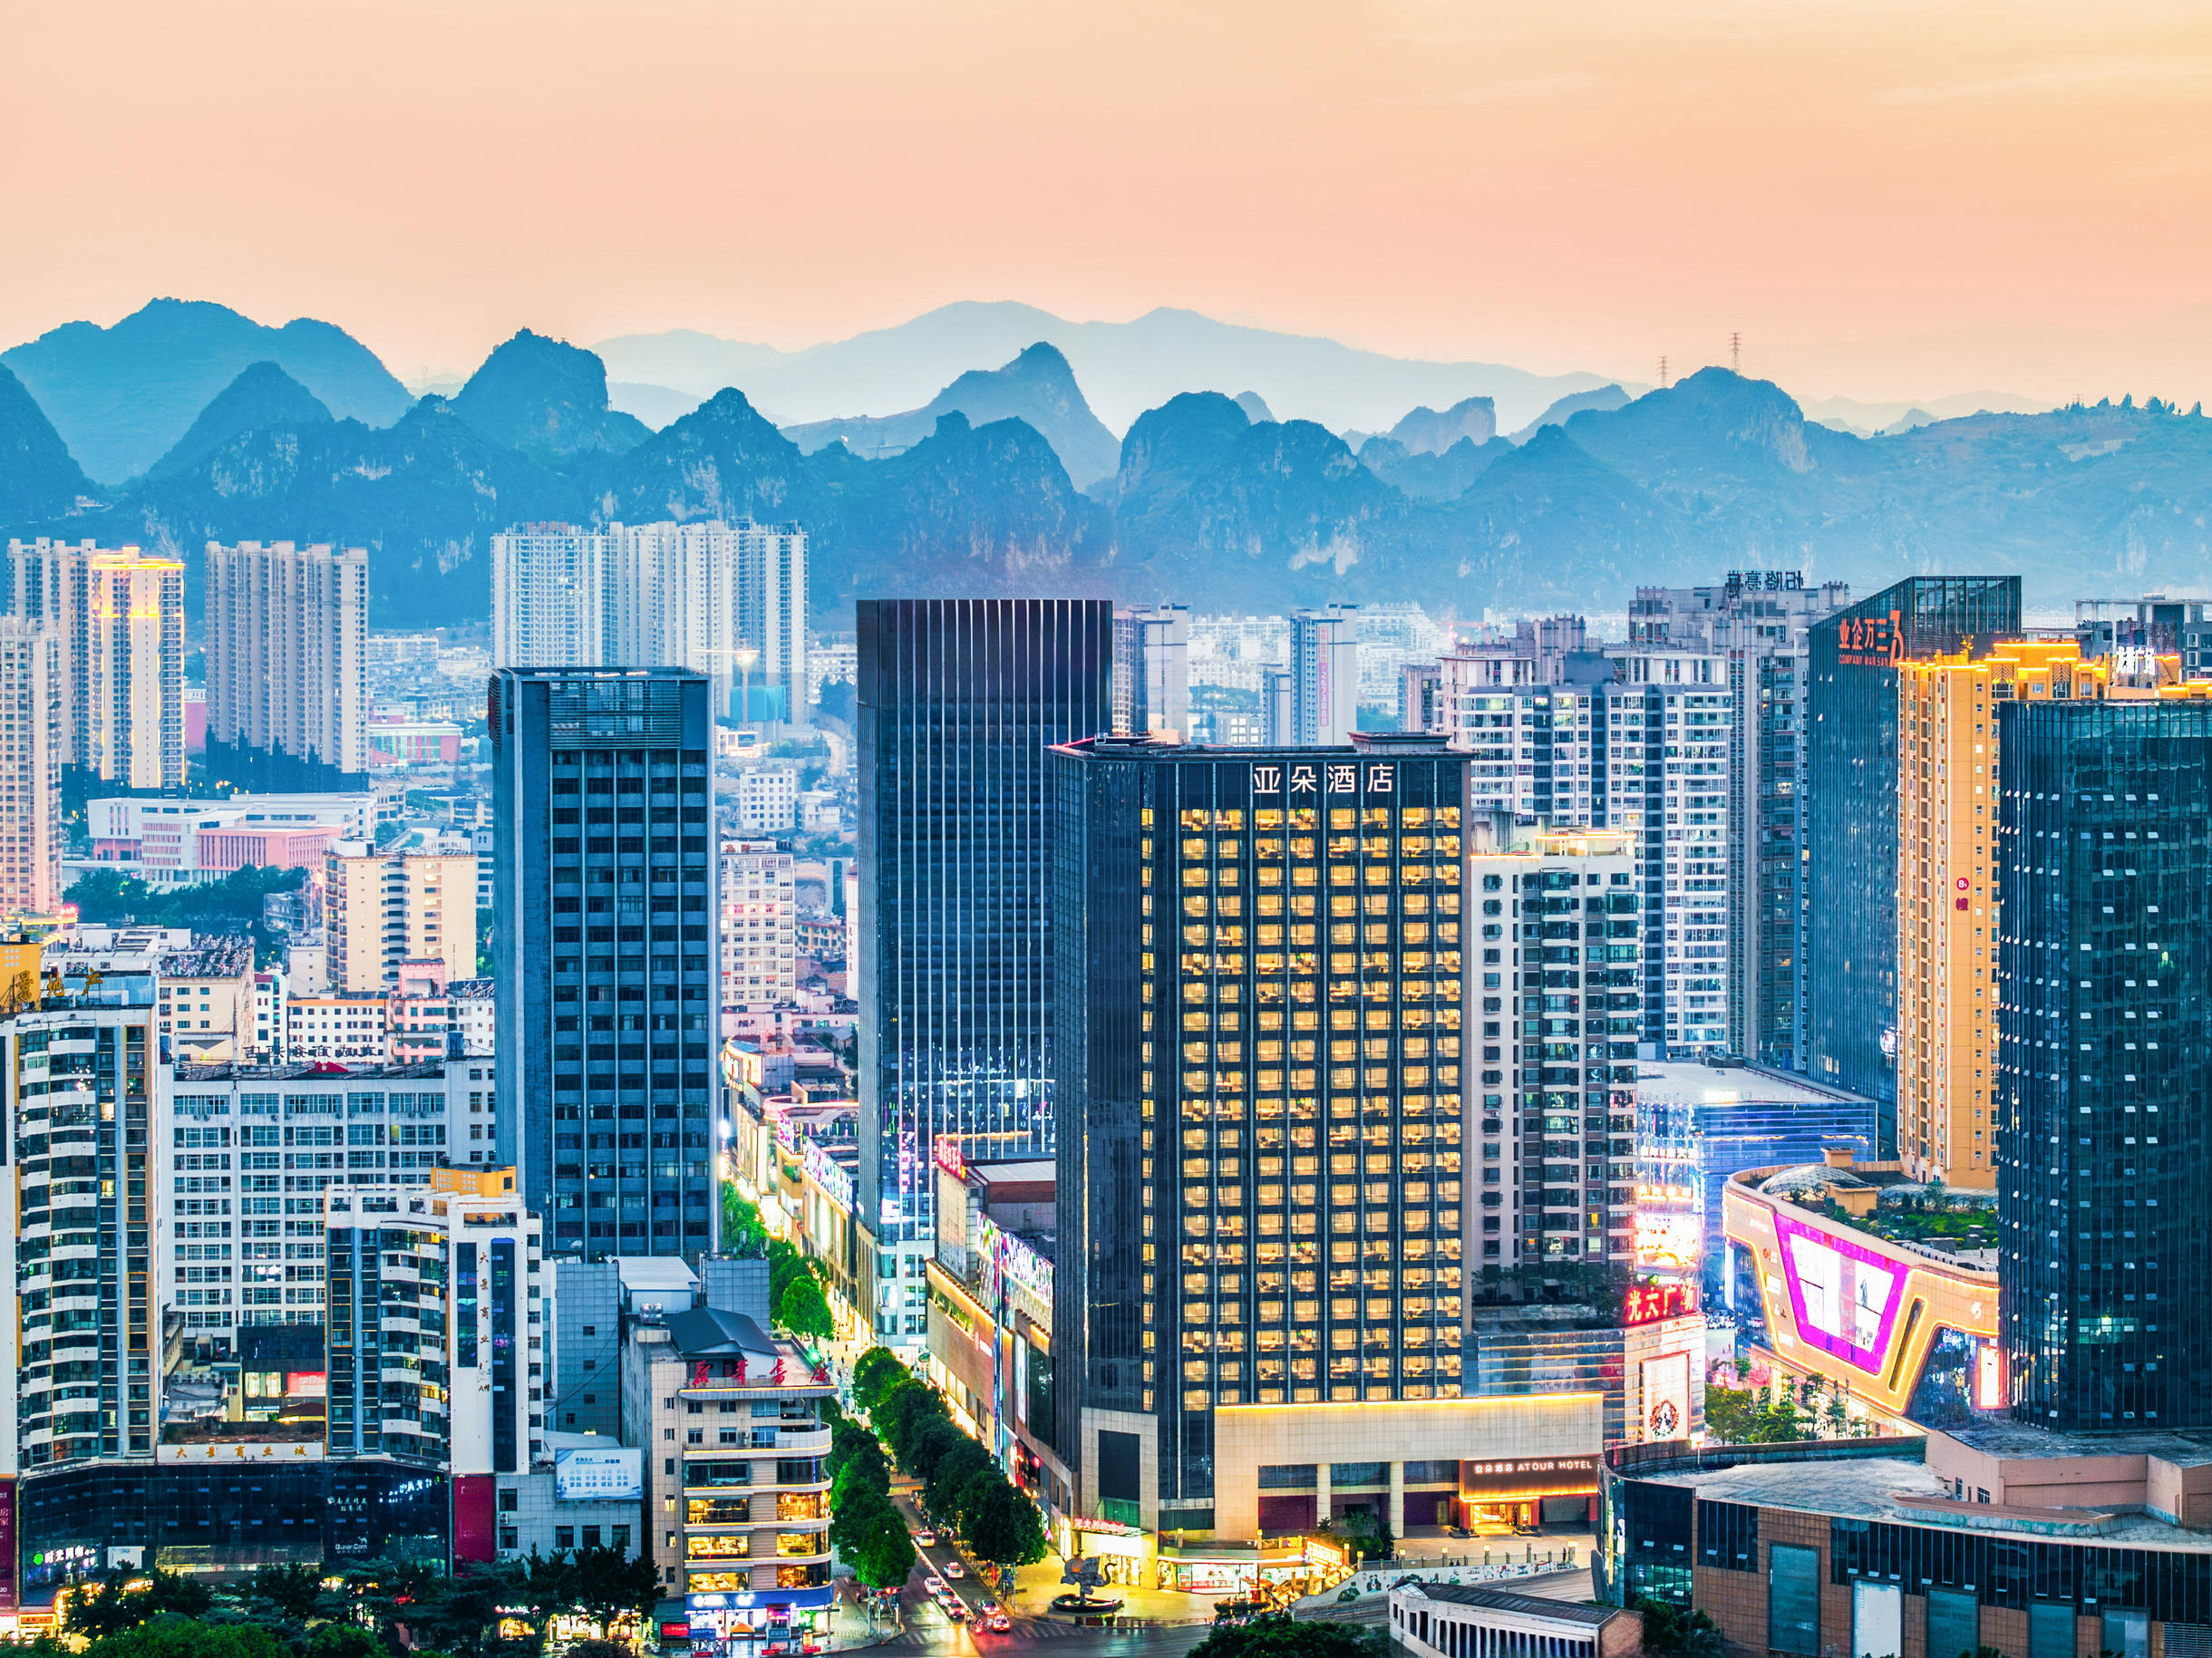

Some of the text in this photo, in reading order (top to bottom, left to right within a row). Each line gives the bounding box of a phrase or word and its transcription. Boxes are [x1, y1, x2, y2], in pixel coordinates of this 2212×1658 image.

[1254, 763, 1394, 794] 亚朵酒店
[176, 1444, 307, 1459] 大景商业城
[1474, 1460, 1593, 1474] 亚朵酒店 ATOUR HOTEL
